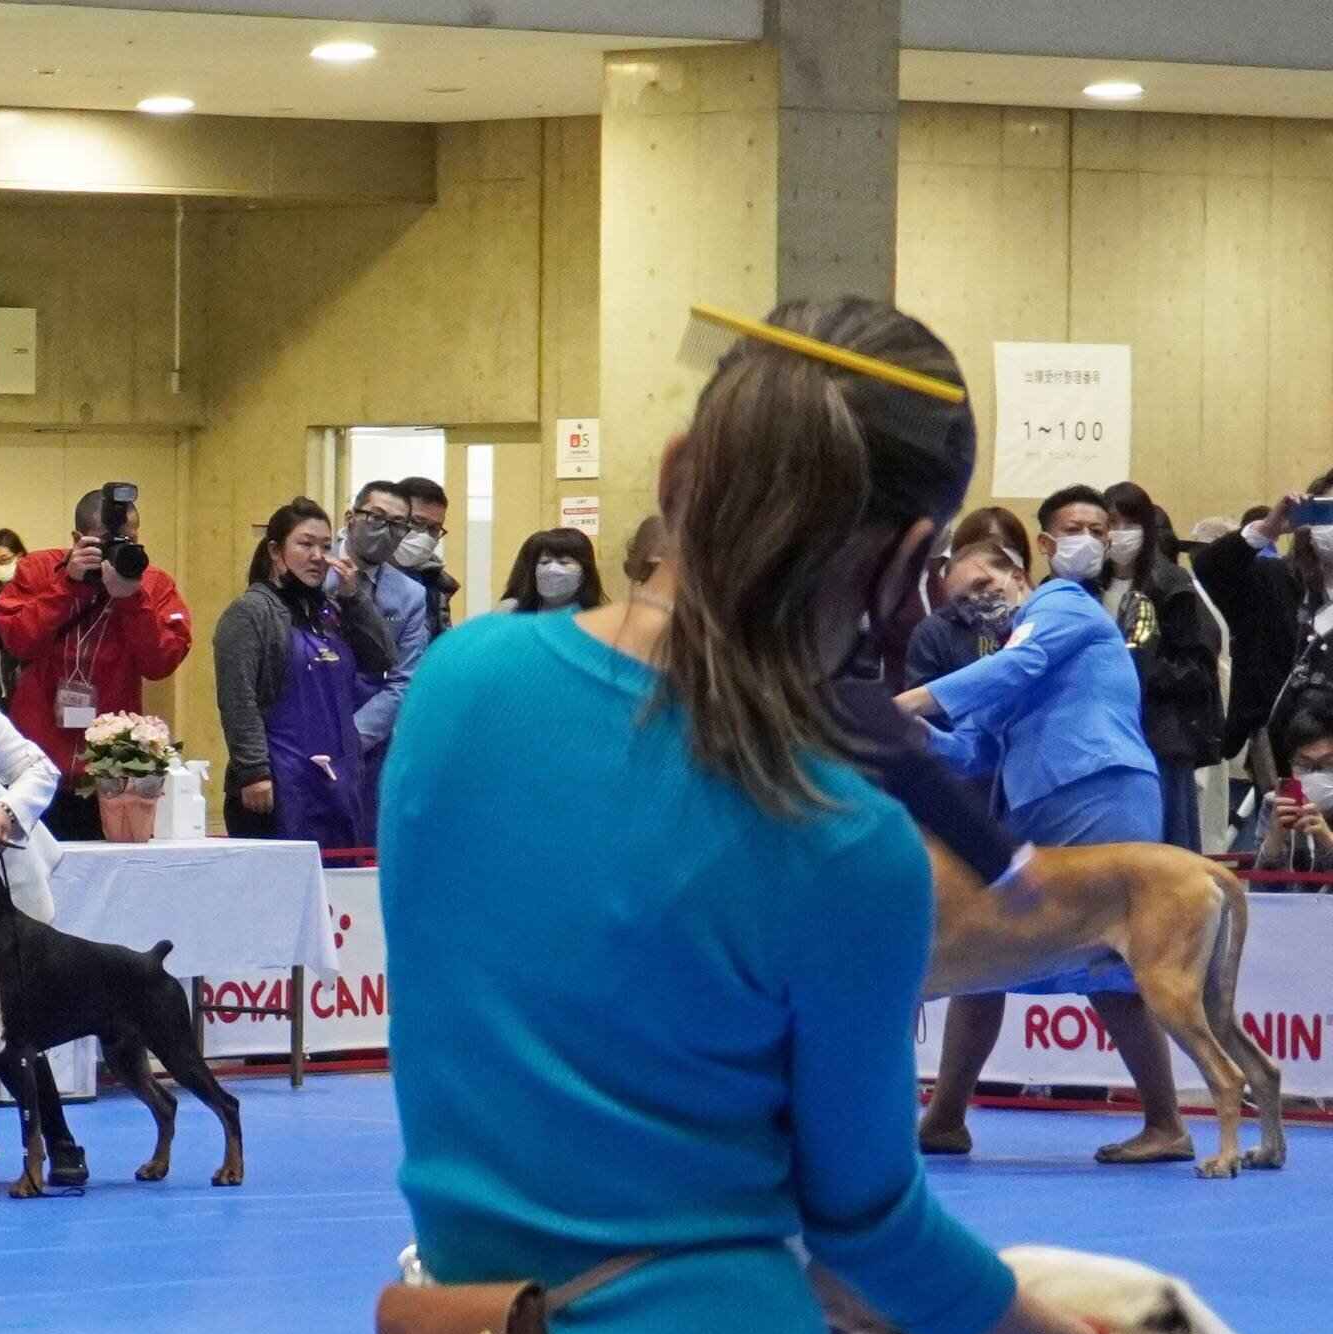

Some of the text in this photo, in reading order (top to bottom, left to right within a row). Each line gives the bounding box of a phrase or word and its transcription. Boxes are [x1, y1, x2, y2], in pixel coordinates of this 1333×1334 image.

[310, 974, 390, 1019] CAN
[1024, 1004, 1321, 1061] ROY NIN
